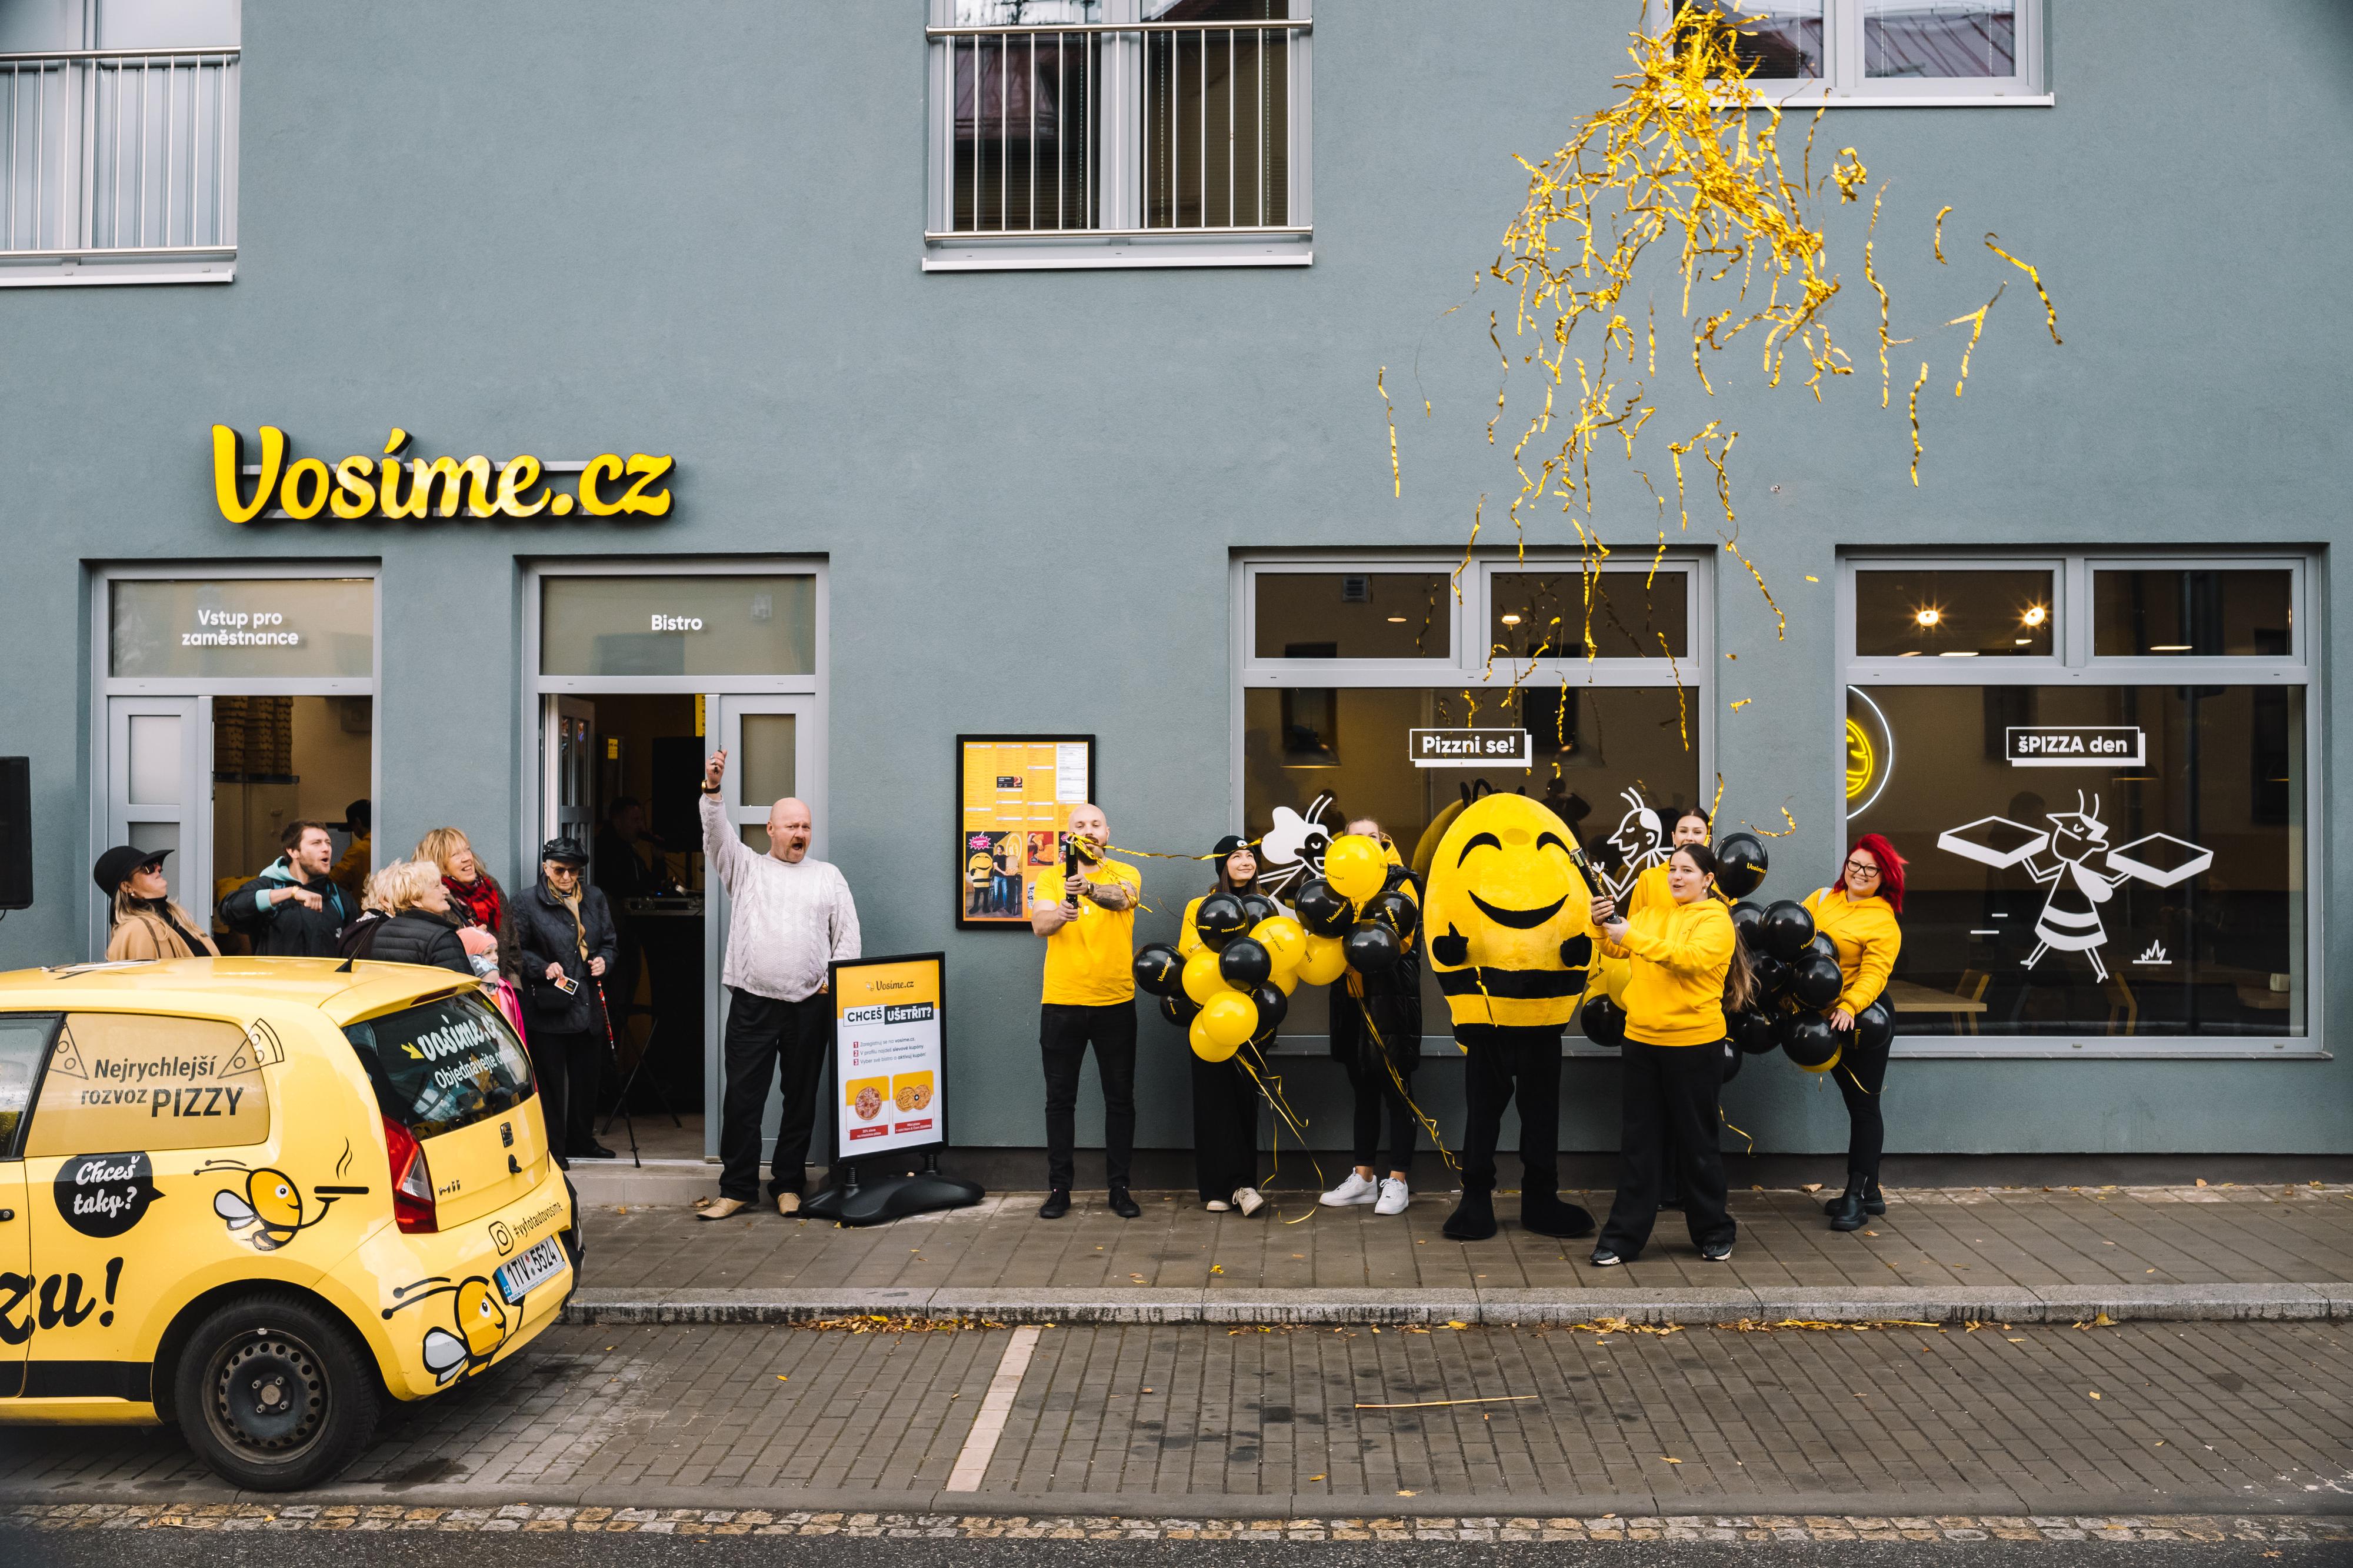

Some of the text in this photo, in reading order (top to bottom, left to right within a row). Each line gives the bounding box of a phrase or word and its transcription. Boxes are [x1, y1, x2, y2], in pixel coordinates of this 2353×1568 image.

[212, 423, 675, 525] Vosíme.cz
[198, 609, 282, 629] Vstup pro
[651, 614, 703, 632] Bistro
[182, 629, 299, 645] zaměstnance
[1422, 735, 1515, 753] Pizzni se!
[2018, 735, 2127, 753] šPIZZA den
[876, 980, 914, 991] Vosíme.cz
[847, 1006, 932, 1022] CHCEŠ UŠETŘIT?
[94, 1055, 218, 1083] Nejrychlejší
[434, 1053, 498, 1089] Objednávejte
[81, 1087, 245, 1117] rozvoz PIZZY
[75, 1156, 141, 1185] Chceš
[74, 1186, 138, 1219] taky?
[507, 1256, 531, 1287] 1TV
[529, 1241, 558, 1273] 5524
[503, 1285, 511, 1293] CZ
